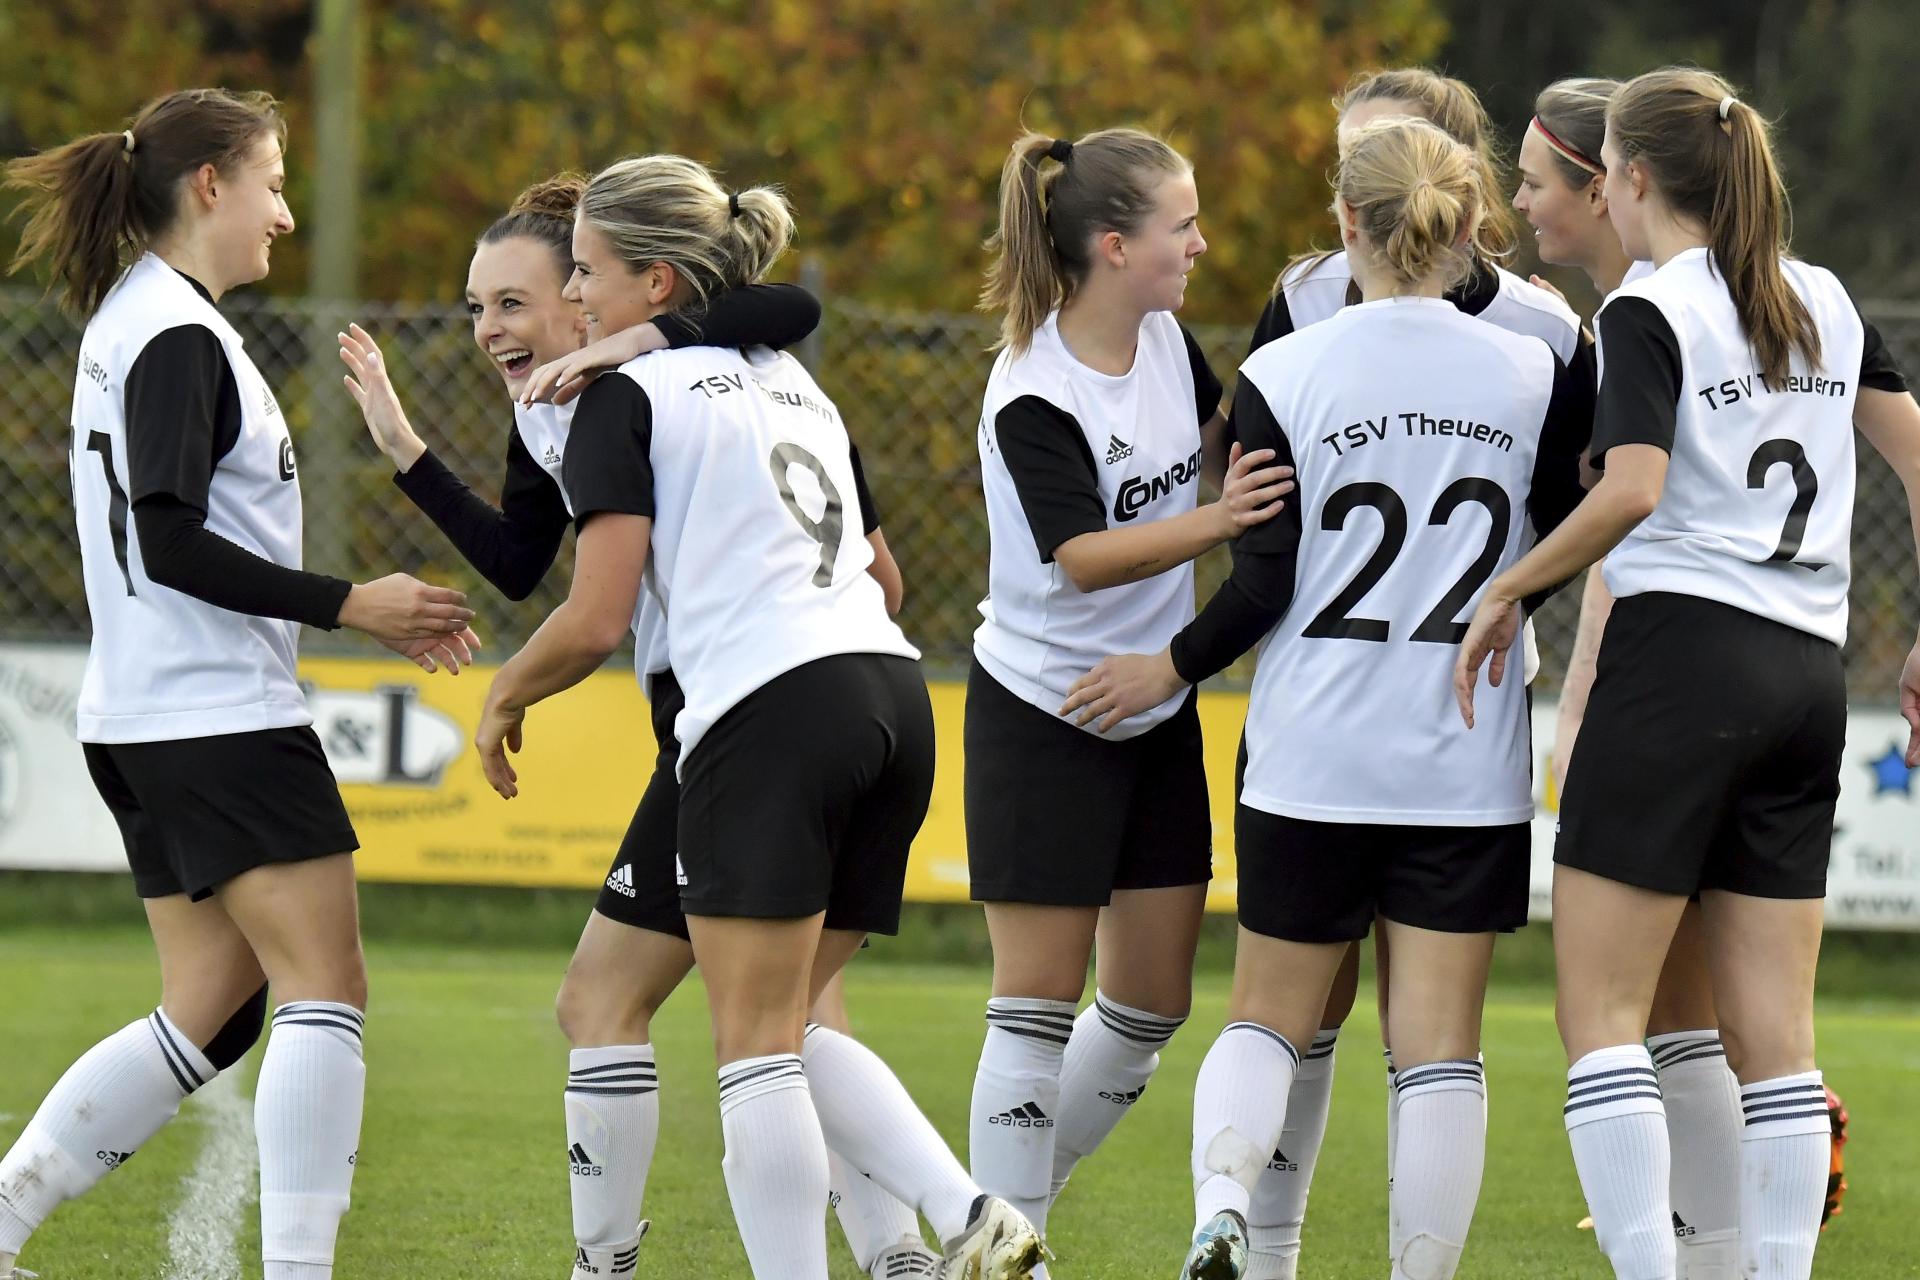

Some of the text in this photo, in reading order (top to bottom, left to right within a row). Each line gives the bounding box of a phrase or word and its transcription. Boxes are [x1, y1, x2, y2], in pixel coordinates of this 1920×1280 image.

[689, 373, 744, 398] TSV
[1698, 374, 1751, 411] TSV
[1321, 412, 1514, 456] TSV Theuern
[769, 442, 843, 588] 9
[1746, 438, 1829, 572] 2
[1301, 476, 1512, 645] 22
[606, 876, 636, 897] adidas
[988, 1115, 1054, 1128] adidas
[571, 1163, 602, 1176] das
